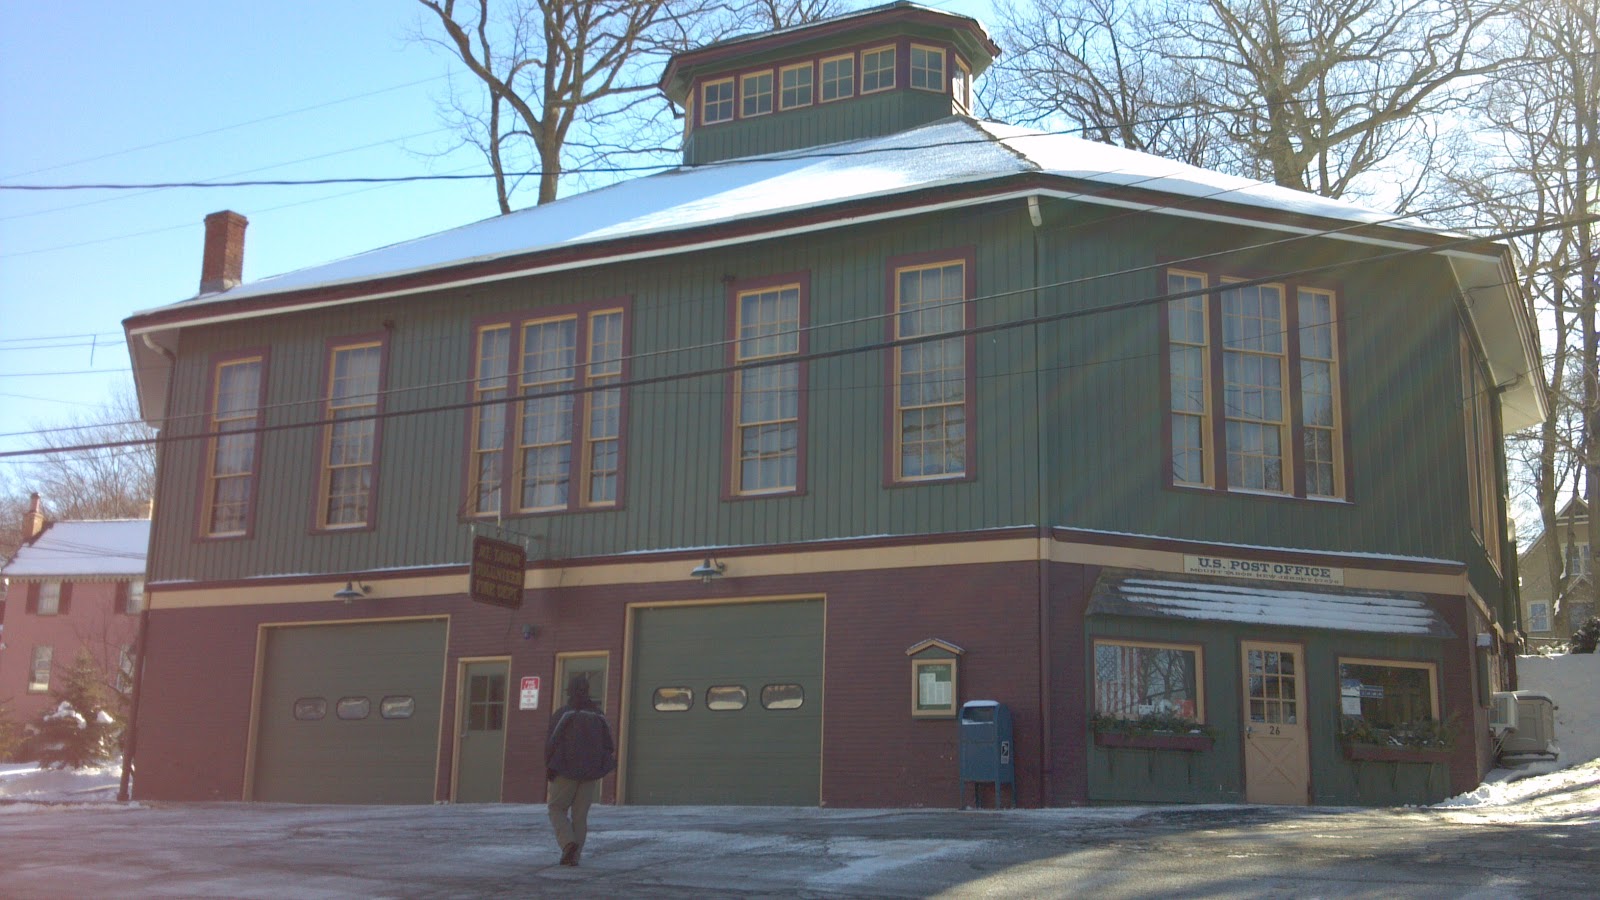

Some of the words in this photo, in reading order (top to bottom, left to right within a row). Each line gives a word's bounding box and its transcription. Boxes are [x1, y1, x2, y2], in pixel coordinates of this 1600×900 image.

[1198, 557, 1226, 569] U.S.
[1230, 560, 1269, 572] POST
[1274, 564, 1330, 578] OFFICE
[1269, 725, 1281, 736] 26
